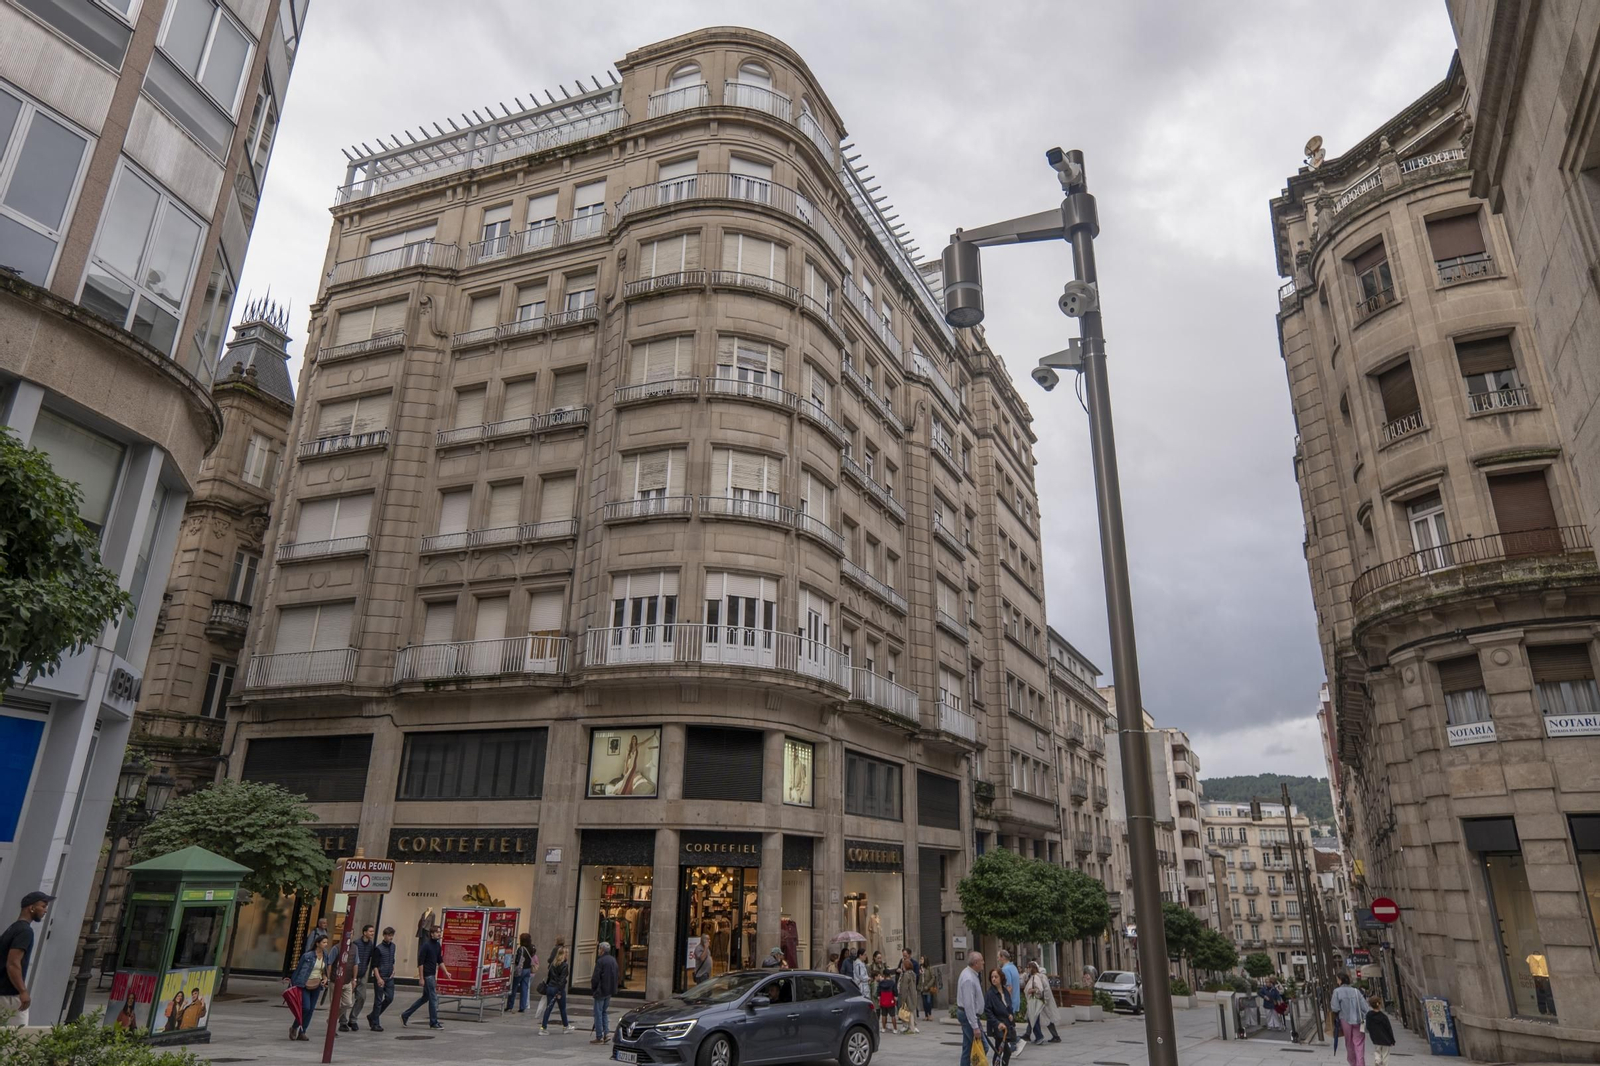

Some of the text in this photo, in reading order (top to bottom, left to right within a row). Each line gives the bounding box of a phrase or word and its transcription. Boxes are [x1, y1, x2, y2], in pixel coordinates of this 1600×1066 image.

[1549, 716, 1600, 728] NOTARÍ
[1450, 724, 1493, 738] NOTARÍA
[397, 836, 525, 853] CORTEFIEL
[685, 843, 757, 853] CORTEFIEL
[848, 847, 902, 863] CORTEFIEL
[346, 860, 394, 871] ZONA PEONIL
